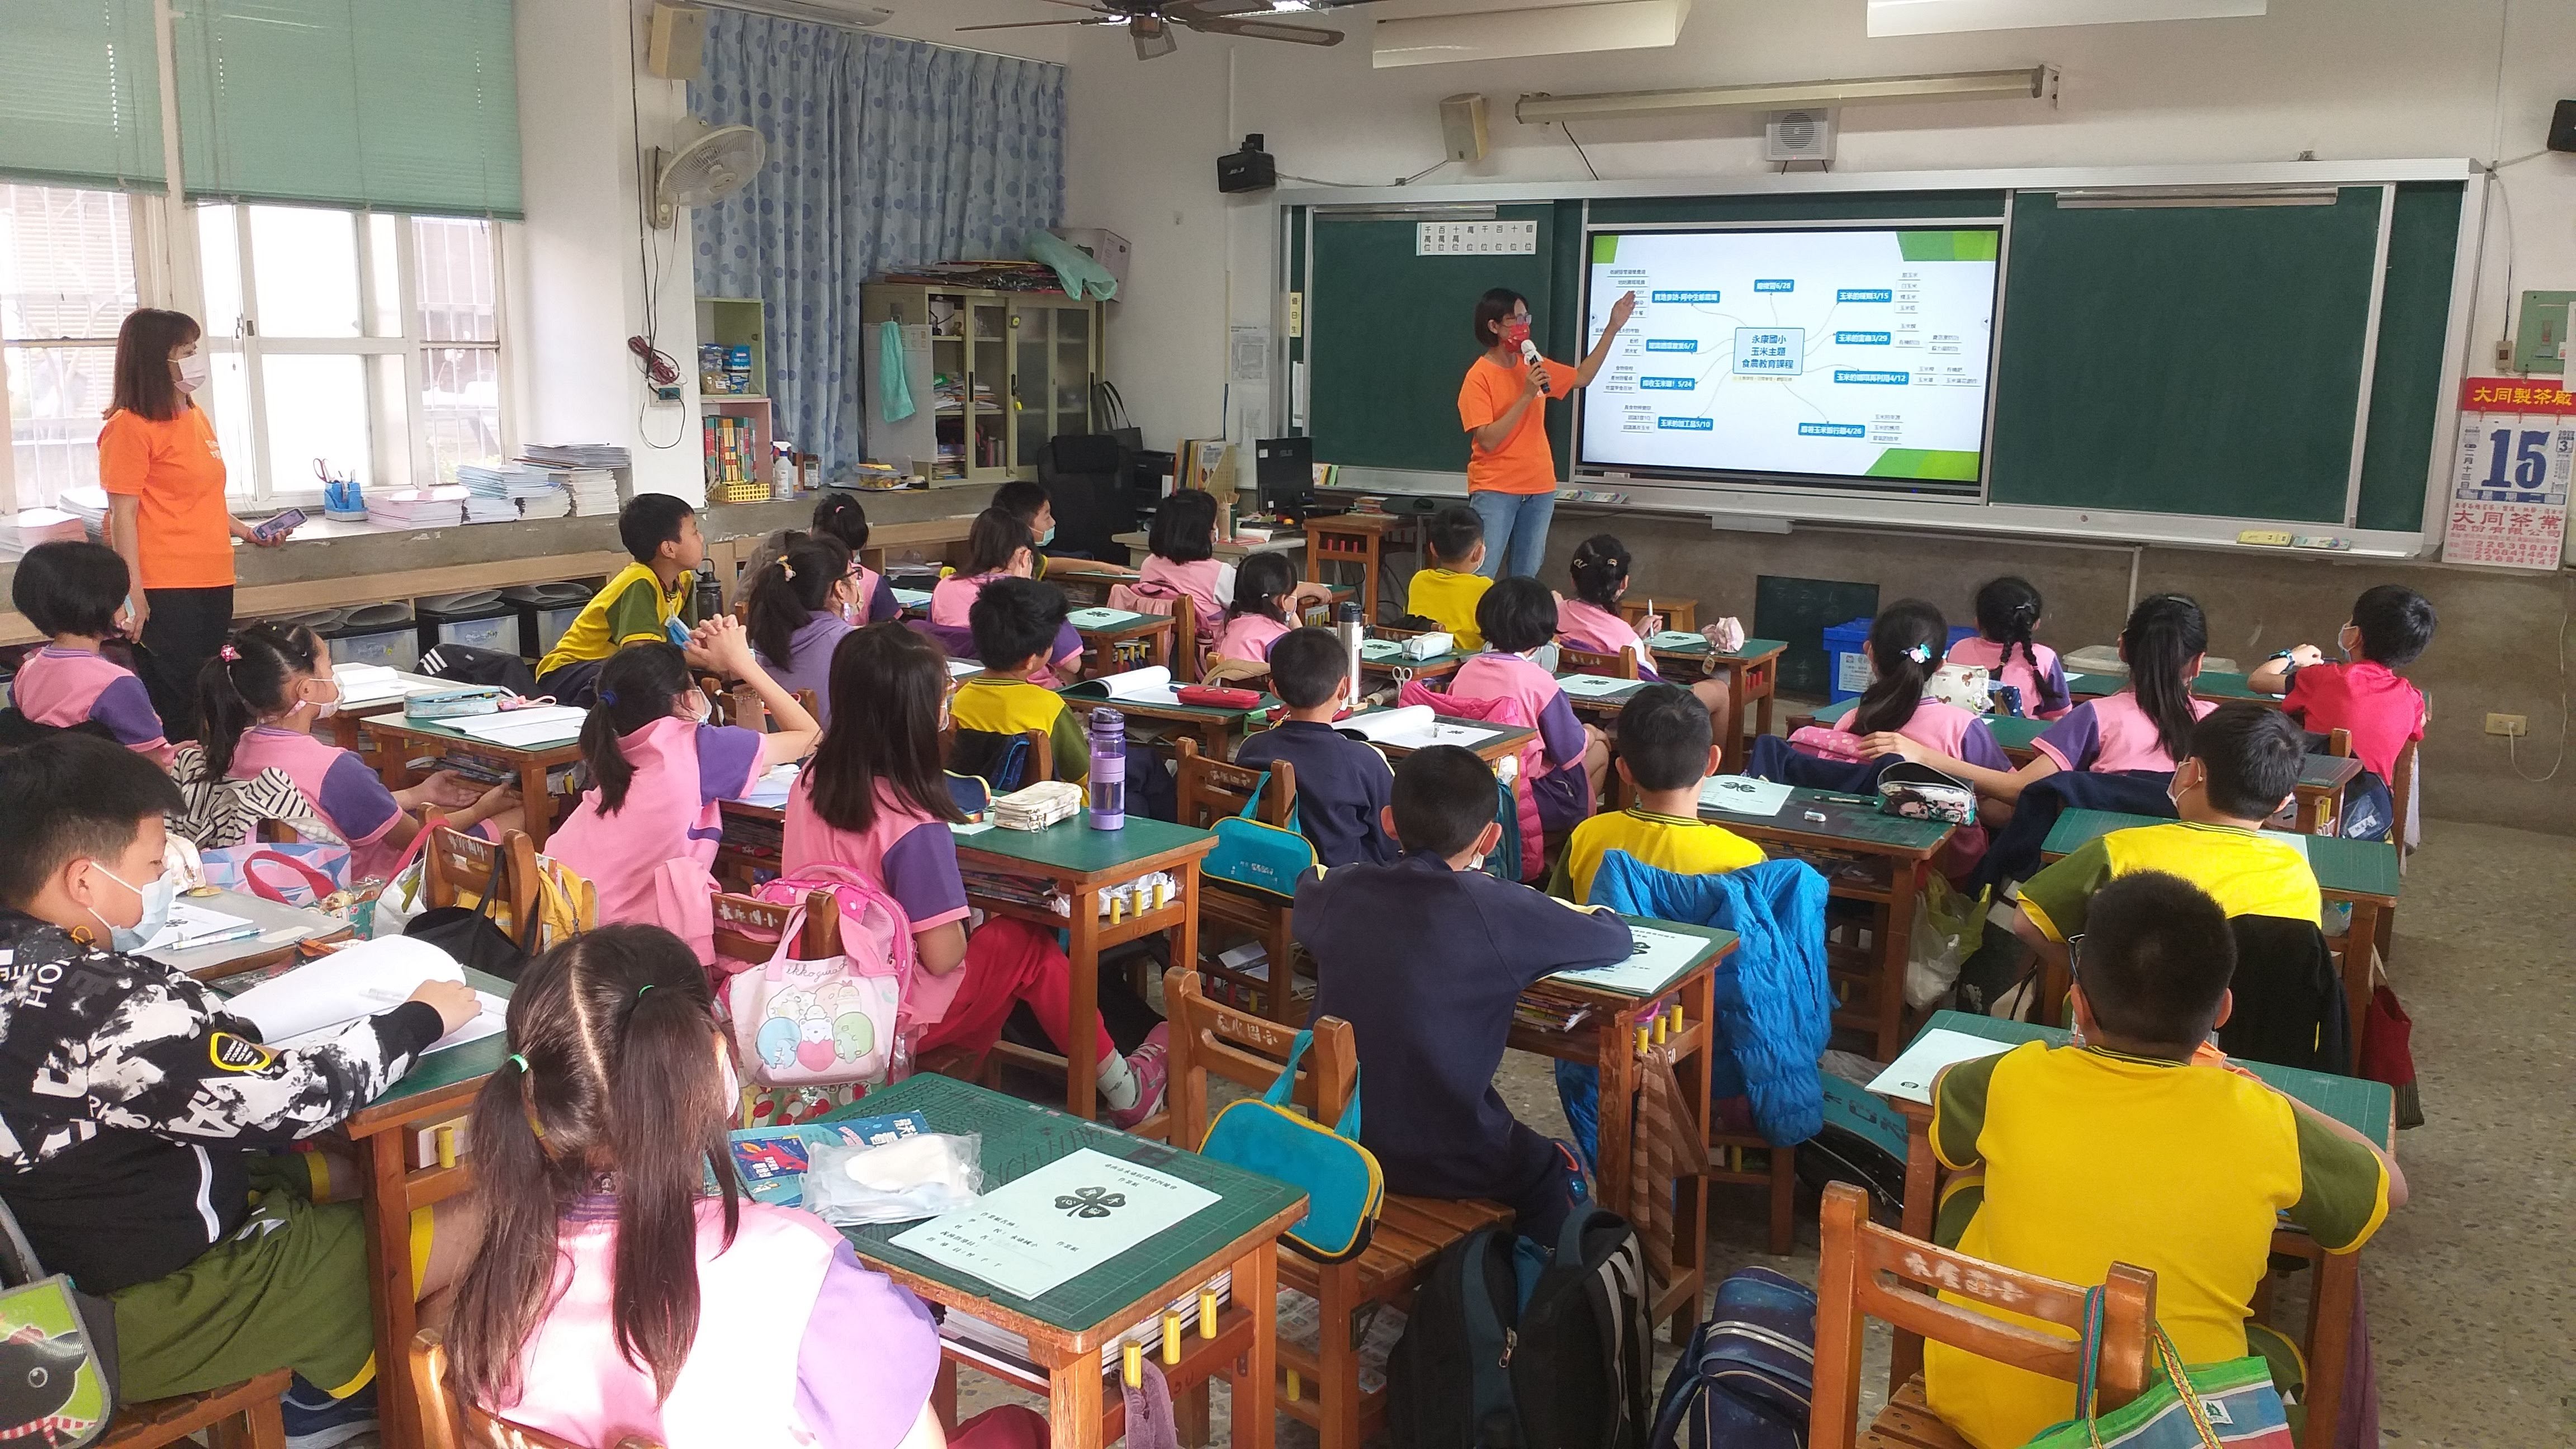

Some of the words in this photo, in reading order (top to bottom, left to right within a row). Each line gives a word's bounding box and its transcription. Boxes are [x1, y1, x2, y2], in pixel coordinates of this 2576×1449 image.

[1751, 335, 1787, 344] 永康國小
[1751, 347, 1786, 356] 玉米主題
[1741, 359, 1794, 369] 食農教育課程
[2473, 386, 2573, 406] 大同製茶廠
[2559, 441, 2568, 452] 3
[2481, 429, 2551, 489] 15
[2452, 510, 2563, 530] 大同茶業
[2451, 523, 2561, 538] 股份有限公司
